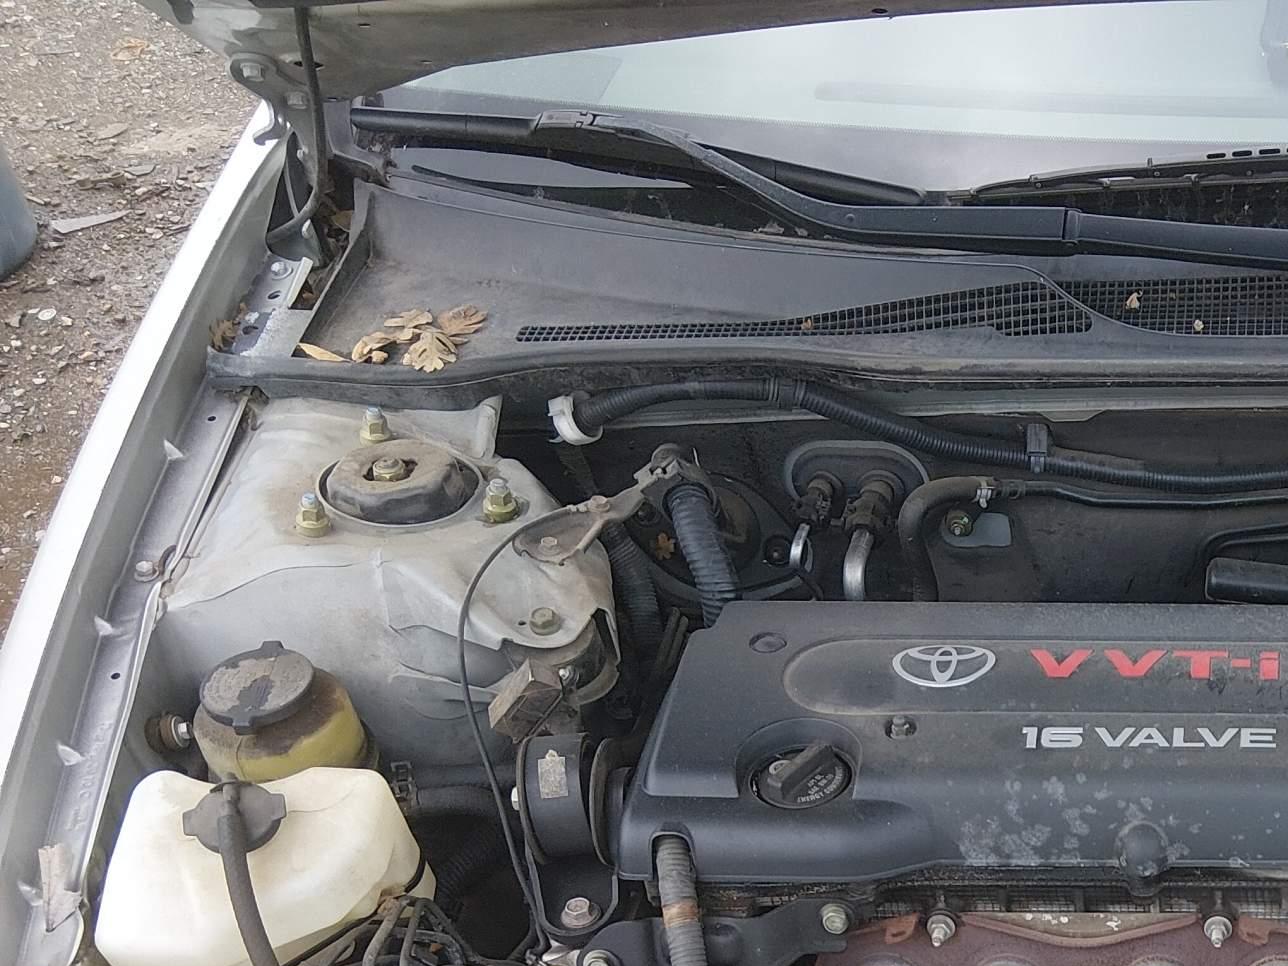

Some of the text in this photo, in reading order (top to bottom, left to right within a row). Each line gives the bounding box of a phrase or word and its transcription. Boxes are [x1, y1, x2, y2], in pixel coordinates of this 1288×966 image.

[1030, 649, 1280, 680] VVT-i
[1022, 726, 1277, 748] 16 VALVE
